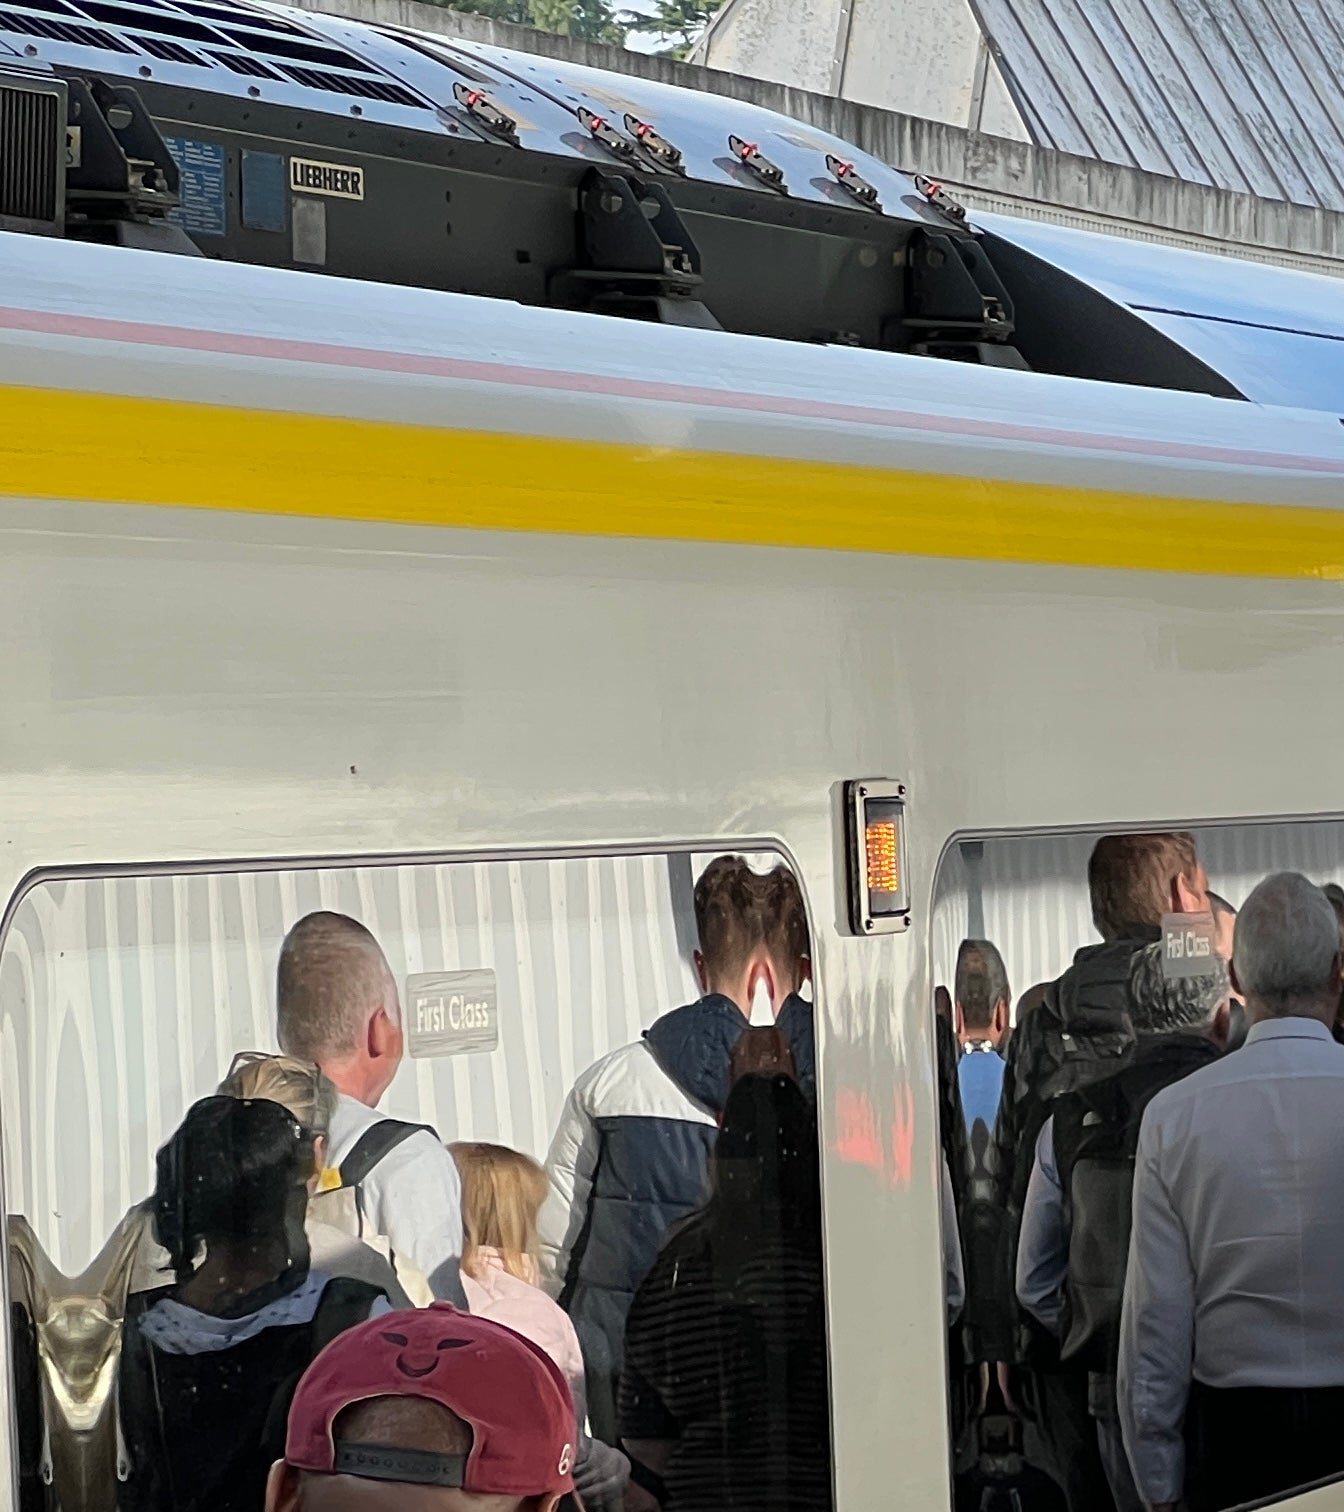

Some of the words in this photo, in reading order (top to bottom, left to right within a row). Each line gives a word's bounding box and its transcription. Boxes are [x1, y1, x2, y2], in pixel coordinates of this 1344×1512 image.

[293, 162, 361, 196] LIEBHERR
[416, 997, 445, 1033] First
[449, 995, 489, 1030] Class
